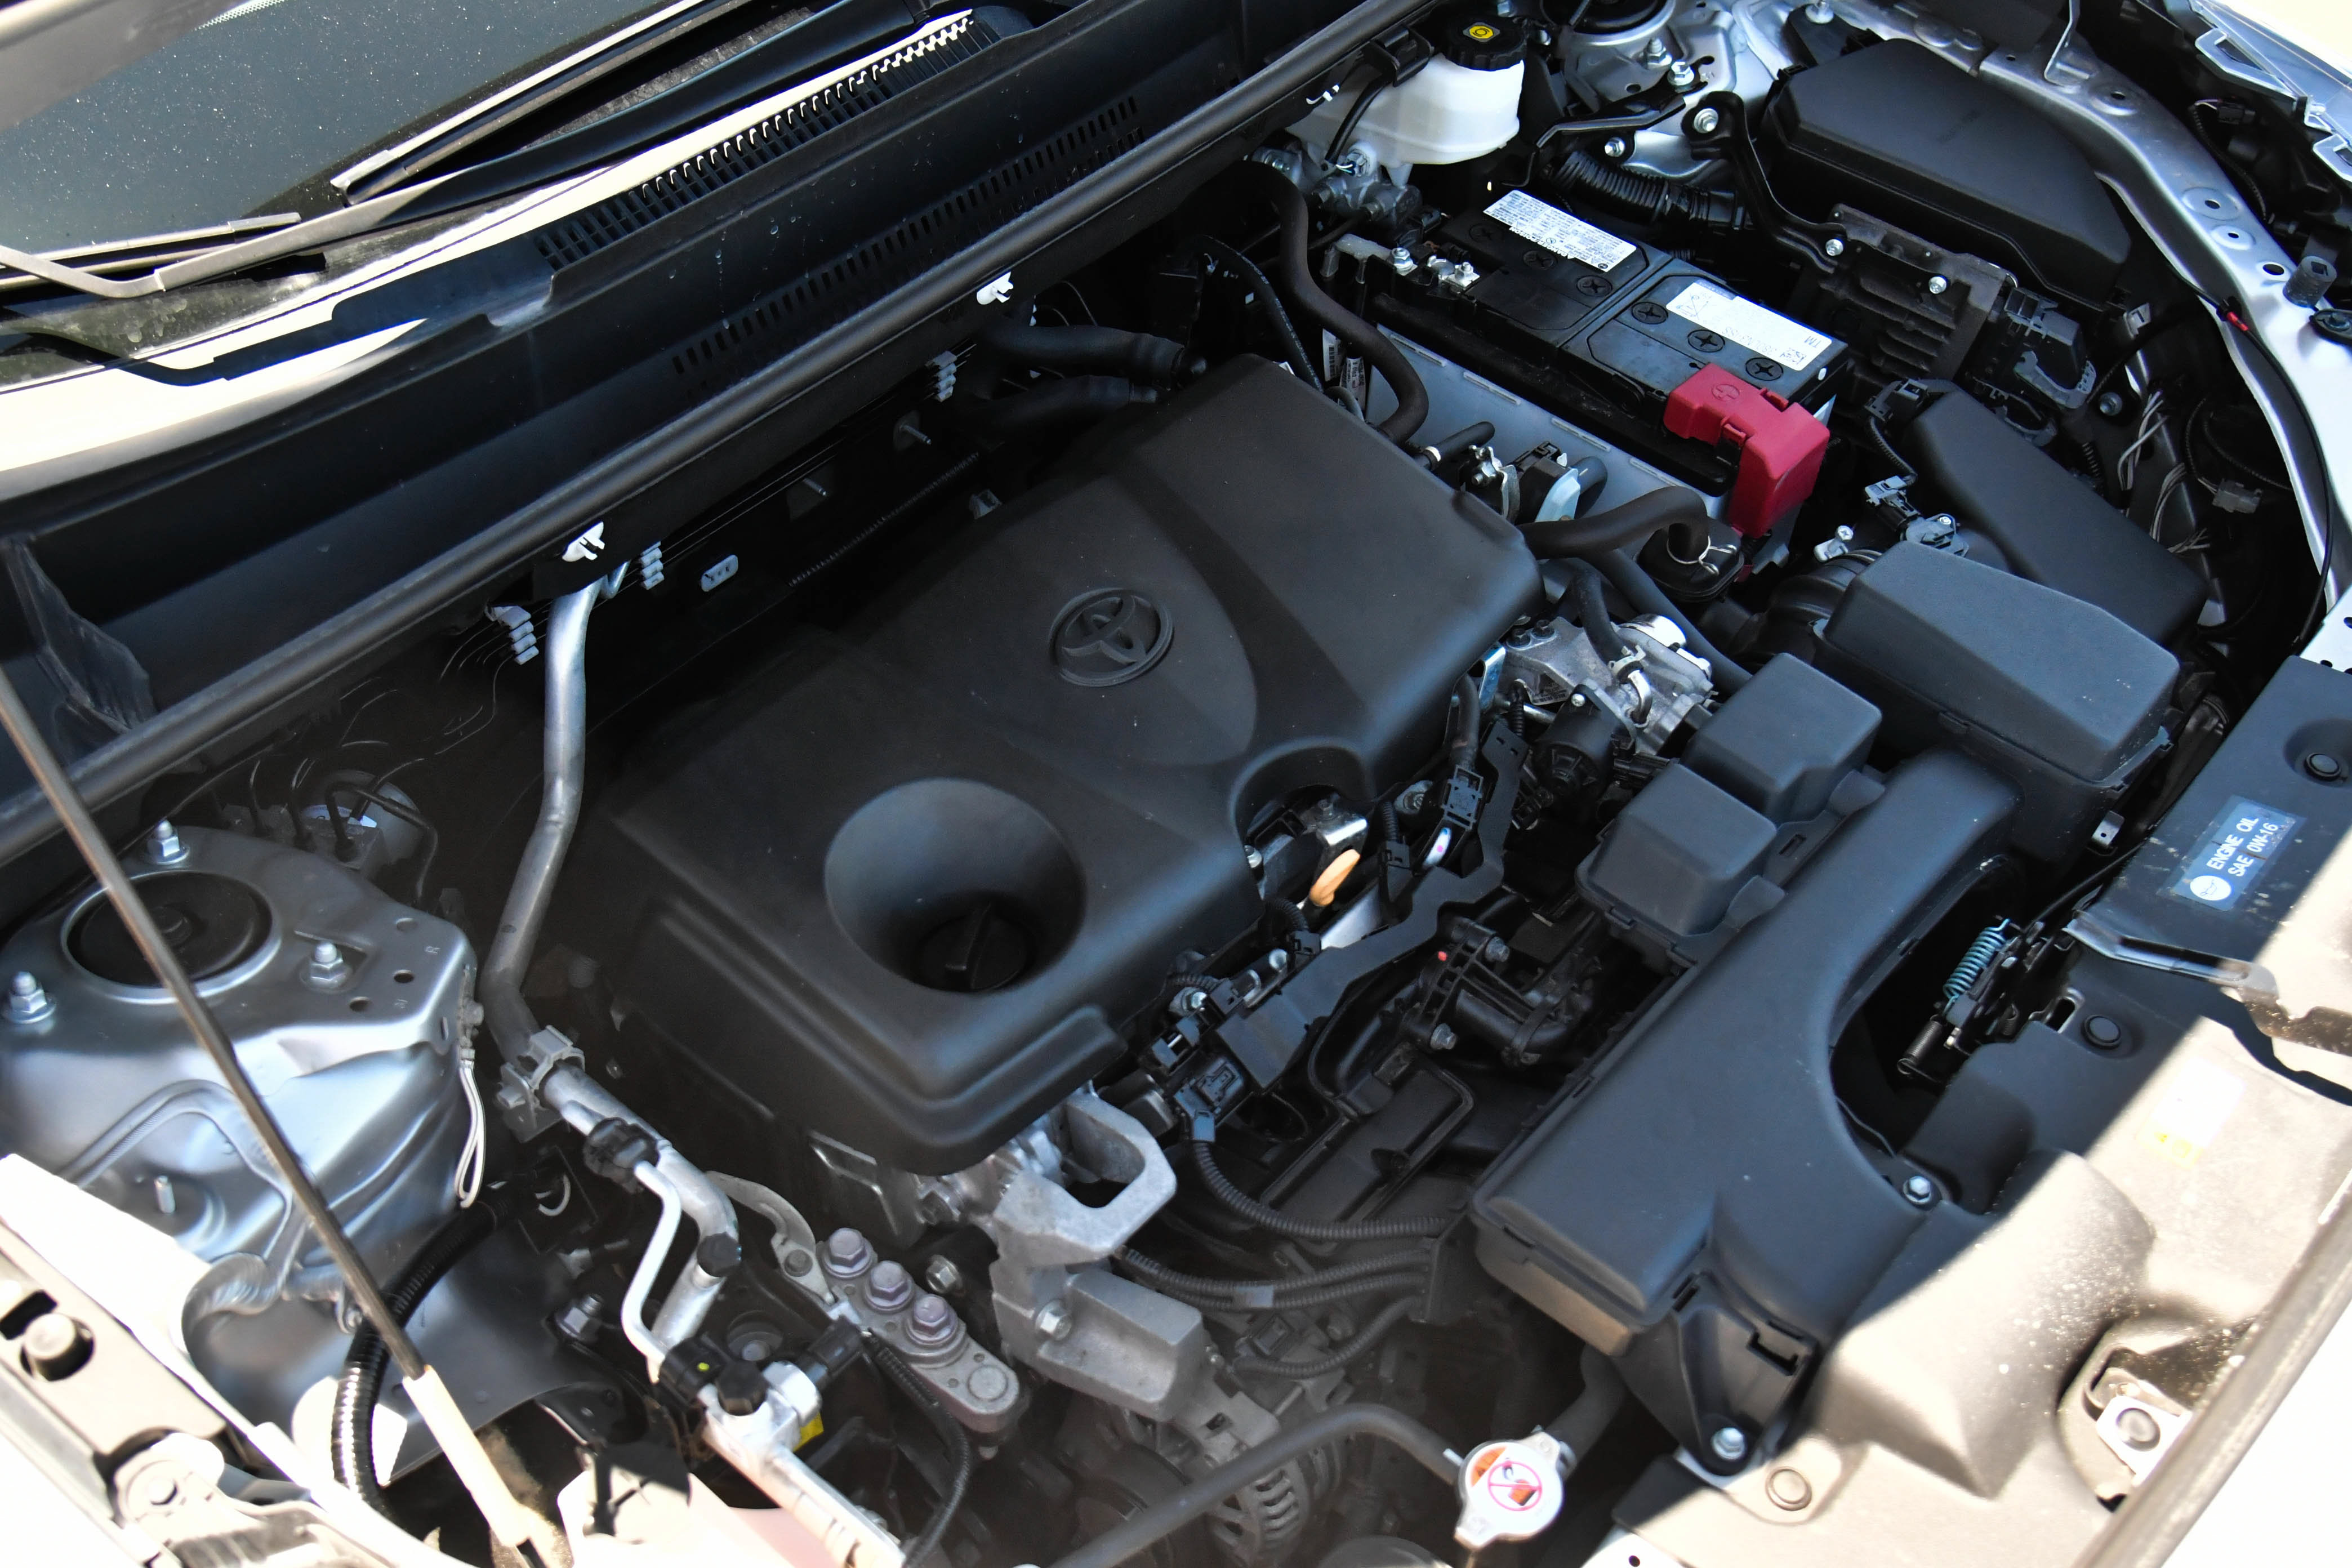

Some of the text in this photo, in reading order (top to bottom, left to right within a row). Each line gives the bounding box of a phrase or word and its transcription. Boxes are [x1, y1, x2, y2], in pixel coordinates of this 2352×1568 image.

[1803, 335, 1821, 348] TM
[2206, 817, 2259, 870] ENGINE OIL
[2228, 823, 2278, 877] SAE 0W-16
